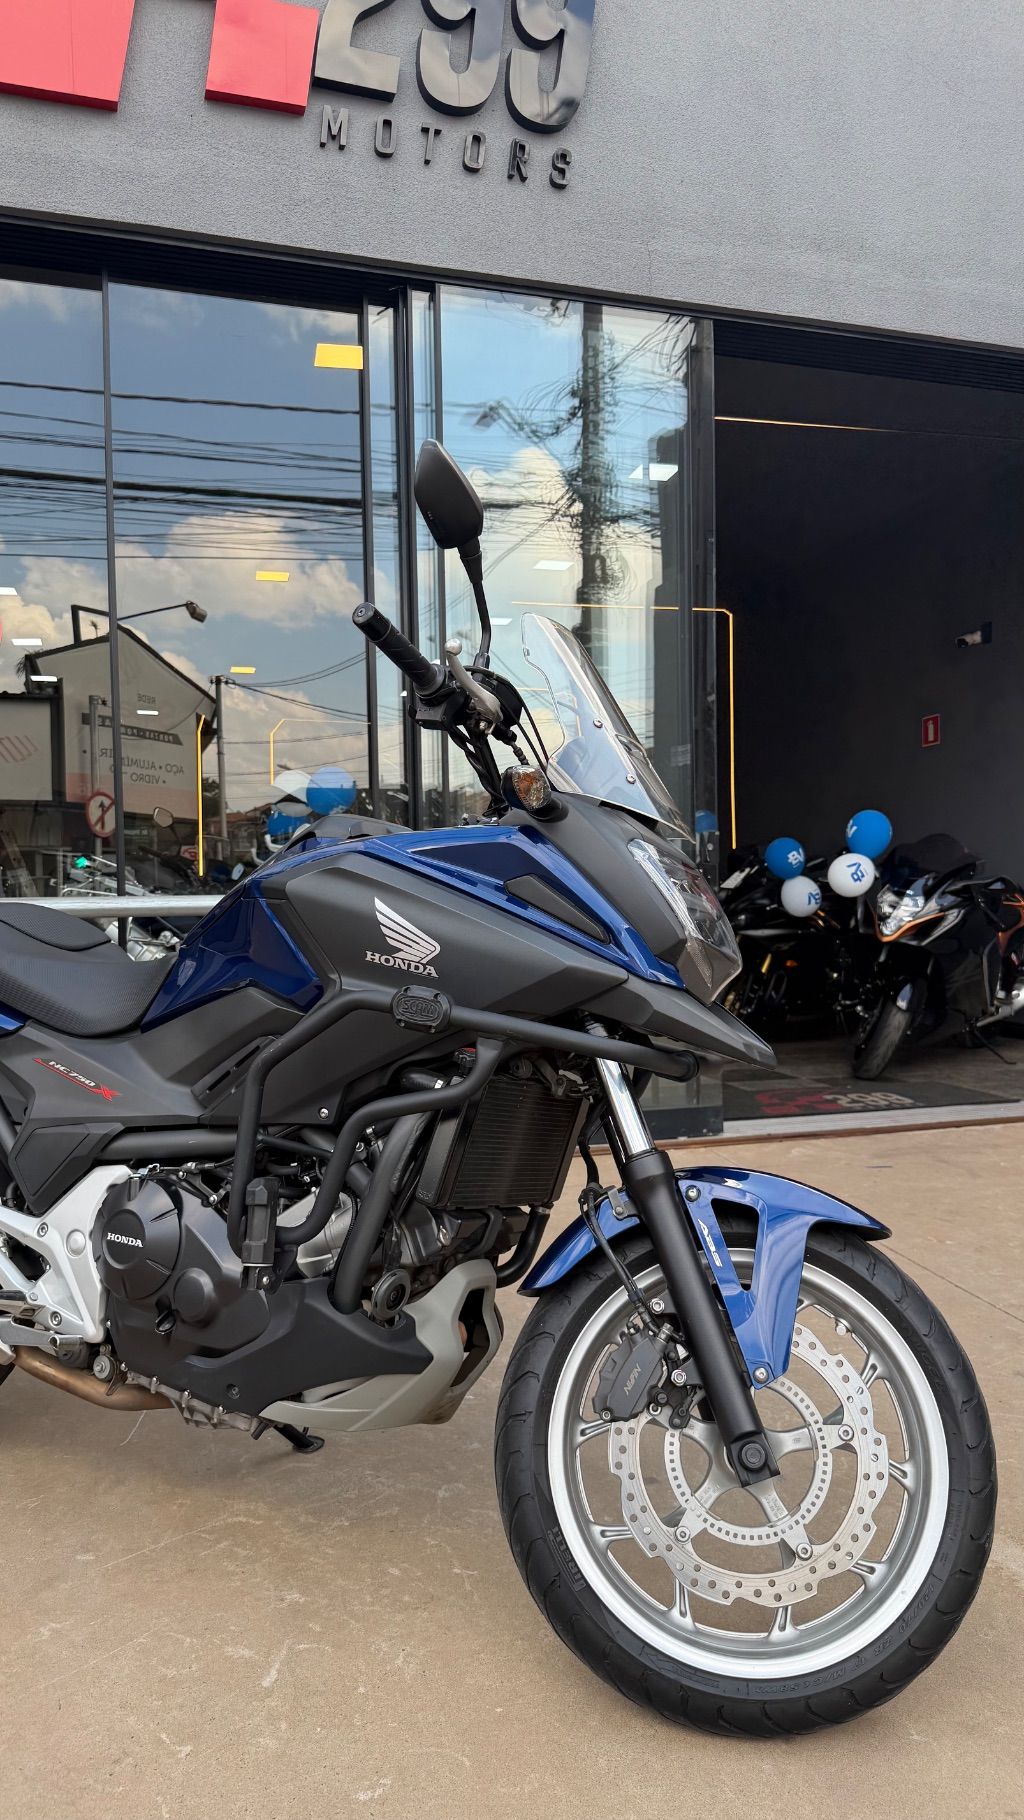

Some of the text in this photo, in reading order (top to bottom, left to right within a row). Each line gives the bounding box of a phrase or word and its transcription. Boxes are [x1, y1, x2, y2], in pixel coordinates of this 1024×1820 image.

[319, 105, 573, 189] MOTORS
[365, 950, 439, 978] HONDA
[48, 1061, 96, 1087] NC750
[107, 1232, 144, 1248] HONDA
[698, 1218, 722, 1267] ABS
